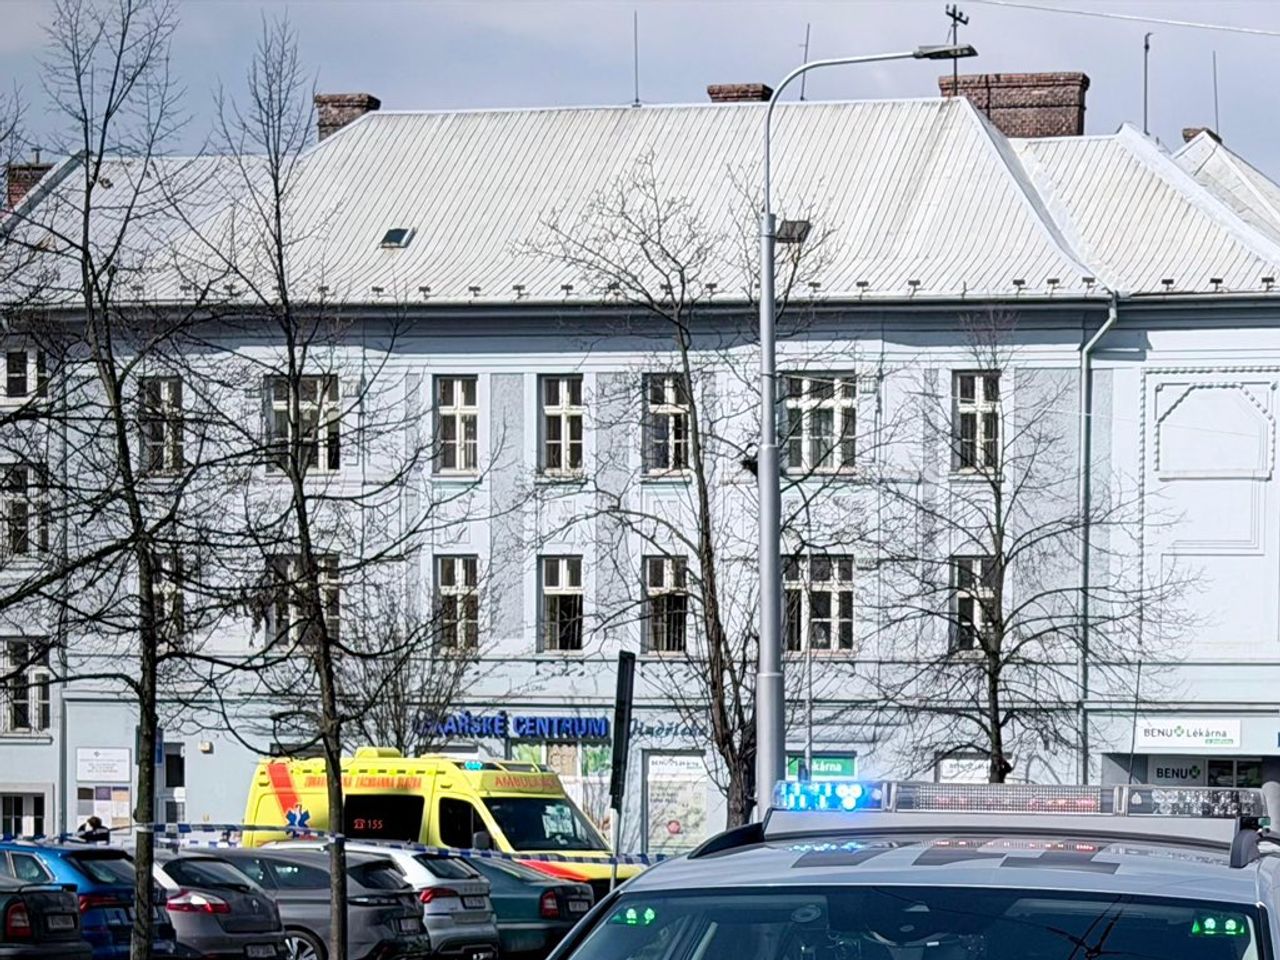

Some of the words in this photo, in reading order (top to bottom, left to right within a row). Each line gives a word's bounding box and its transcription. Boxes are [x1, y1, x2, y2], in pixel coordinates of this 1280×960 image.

[513, 716, 608, 738] CENTRUM
[1144, 728, 1173, 738] BENU
[1187, 727, 1228, 738] Lékárna
[1156, 767, 1188, 779] BENU
[368, 819, 384, 830] 155
